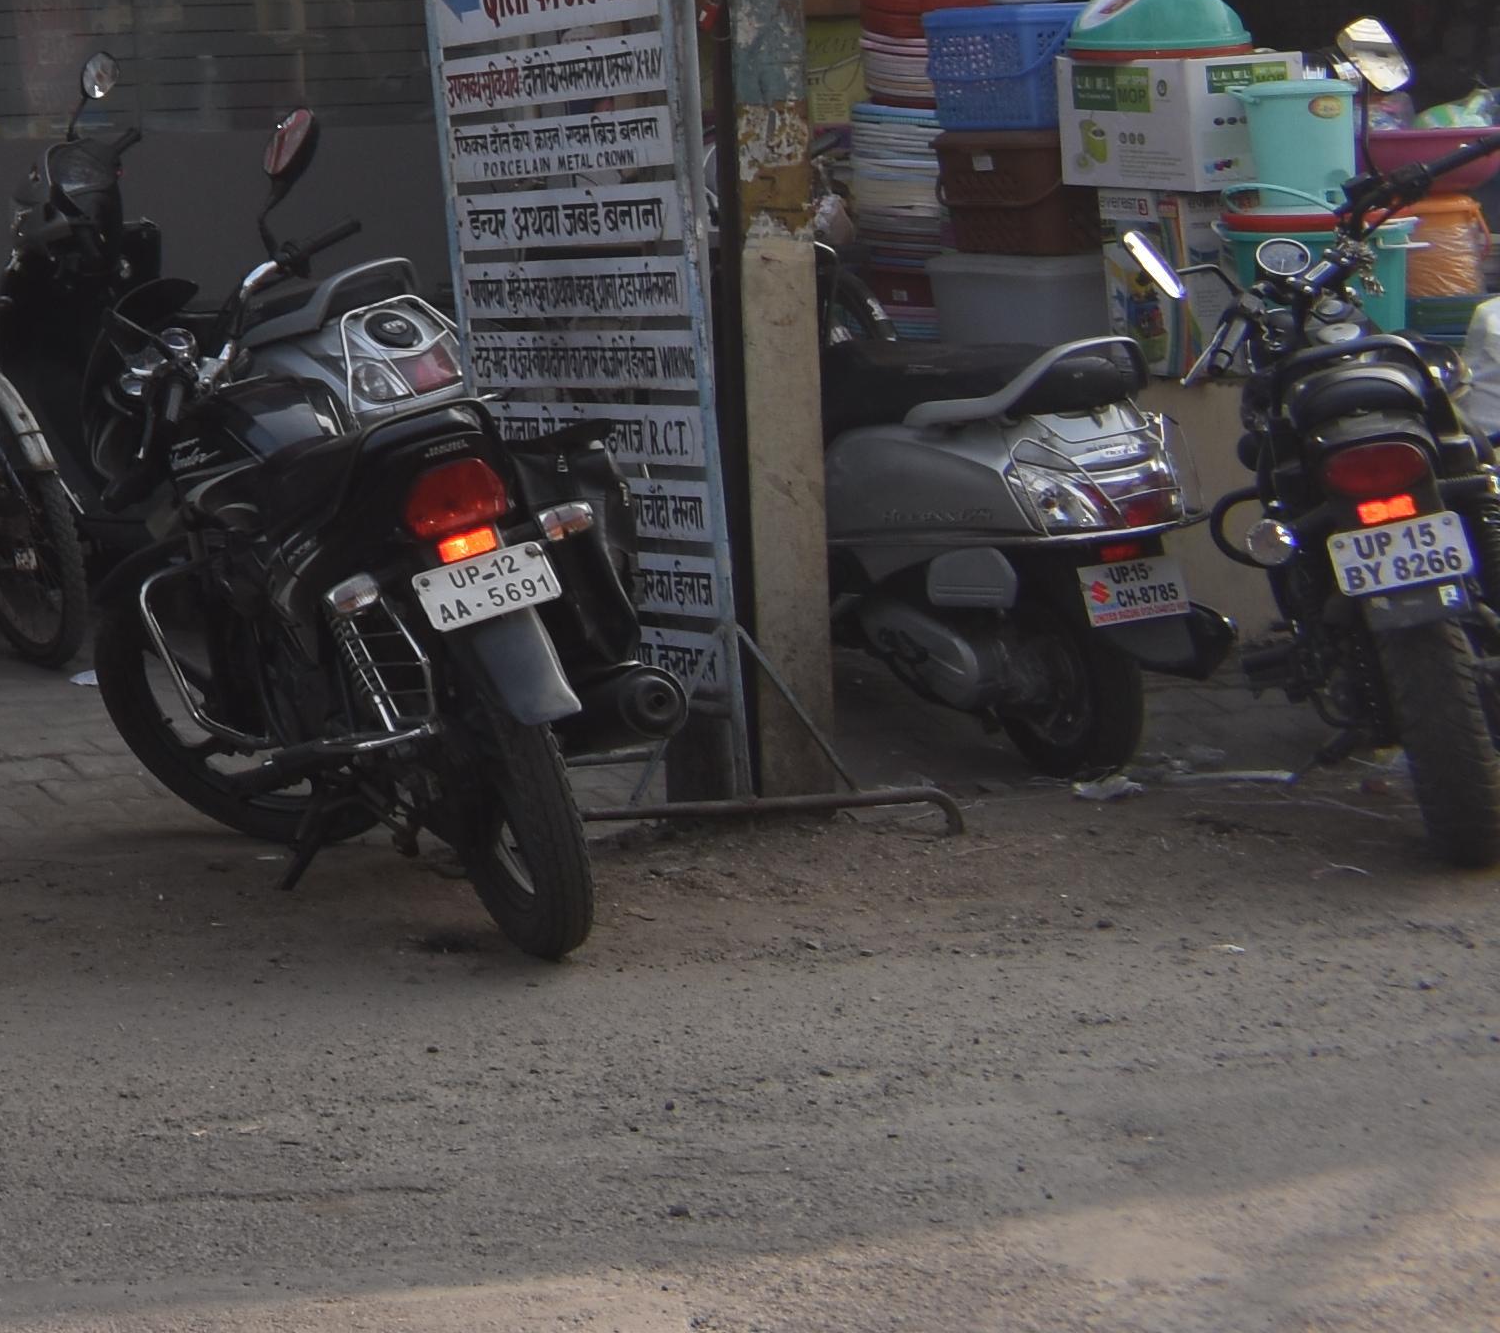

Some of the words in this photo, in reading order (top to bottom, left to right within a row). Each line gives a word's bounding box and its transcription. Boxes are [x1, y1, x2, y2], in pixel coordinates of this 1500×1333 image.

[1117, 87, 1148, 105] MOP
[557, 151, 593, 172] METAL
[511, 204, 561, 241] अथवा
[1353, 531, 1393, 560] UP
[1401, 521, 1437, 550] 15
[448, 554, 520, 591] UP-12
[1343, 561, 1383, 590] BY
[1392, 545, 1463, 582] 8266
[1115, 582, 1180, 608] CH-8785
